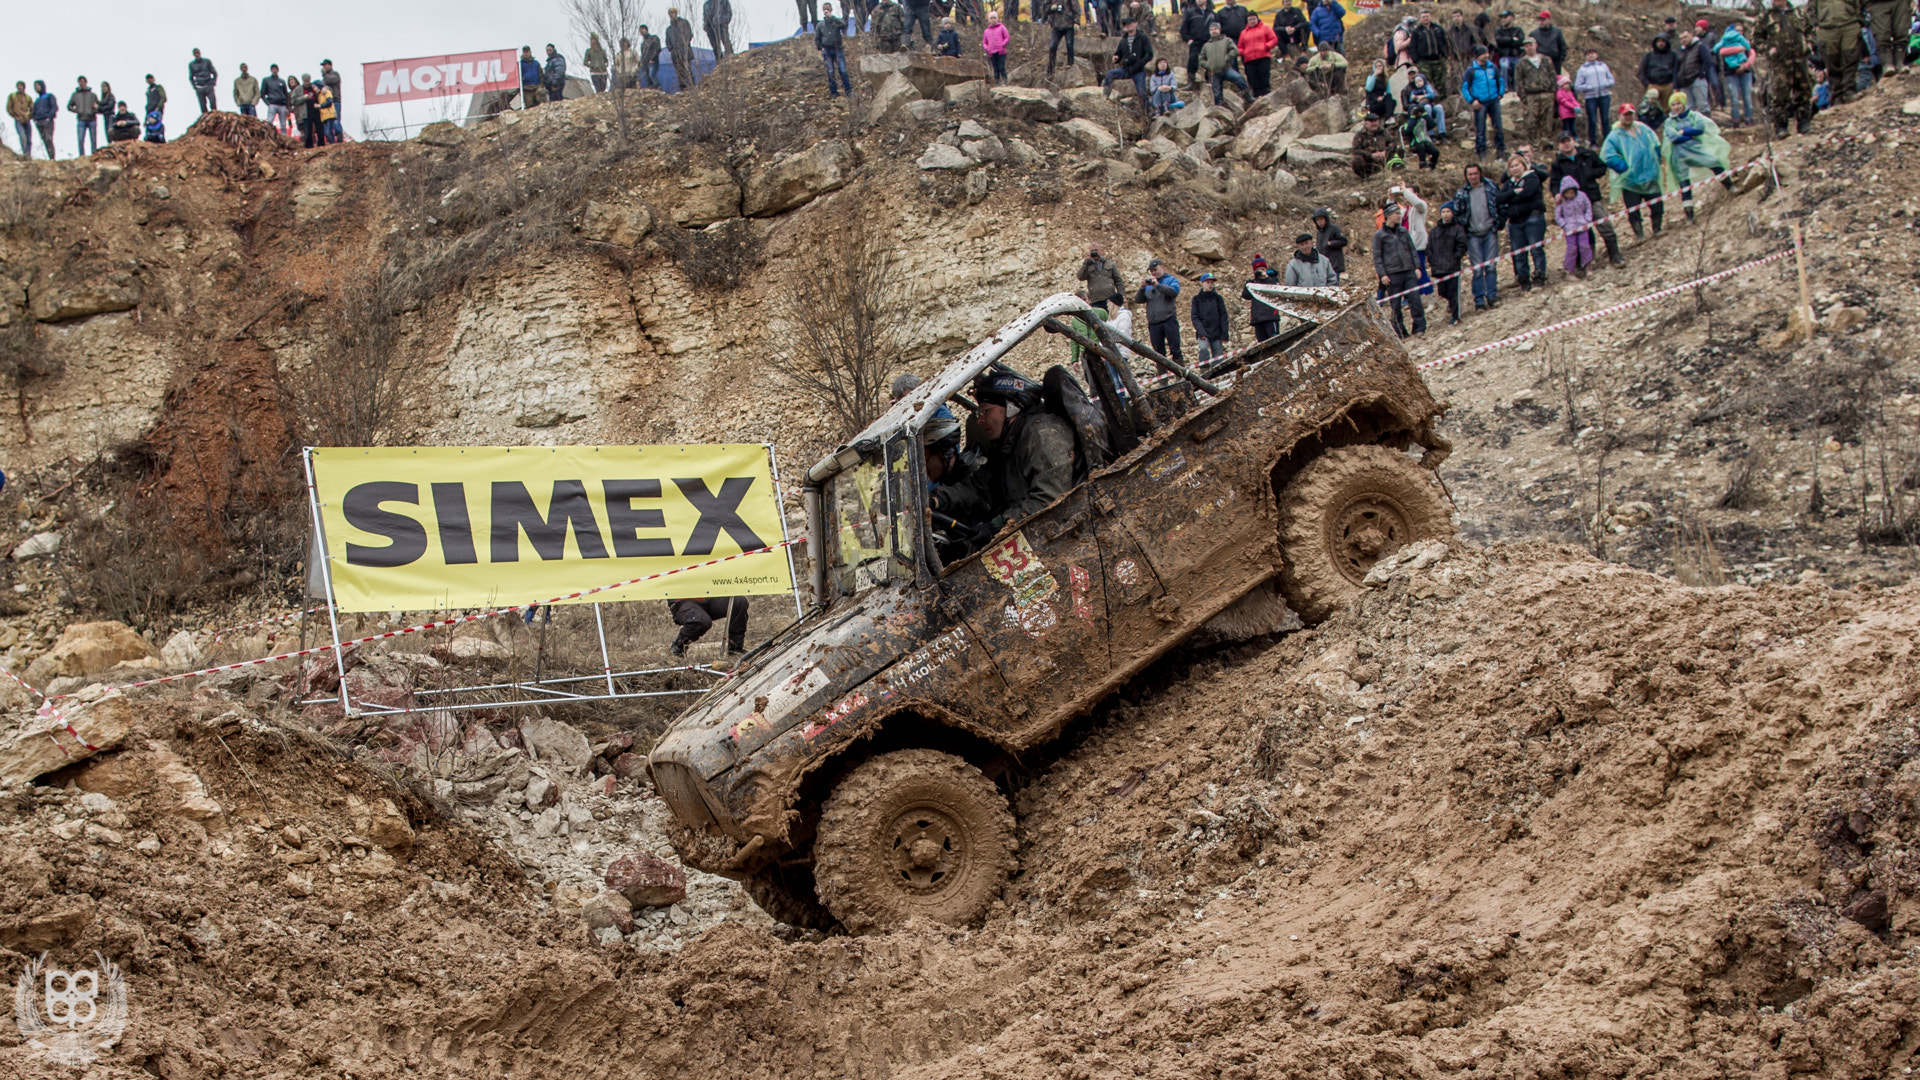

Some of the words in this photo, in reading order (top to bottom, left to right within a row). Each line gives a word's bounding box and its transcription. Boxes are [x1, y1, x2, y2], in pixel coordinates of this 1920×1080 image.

[375, 59, 508, 96] MOTUL
[342, 476, 772, 568] SIMEX
[990, 539, 1028, 580] 53
[712, 576, 779, 586] www.4x4sport.ru
